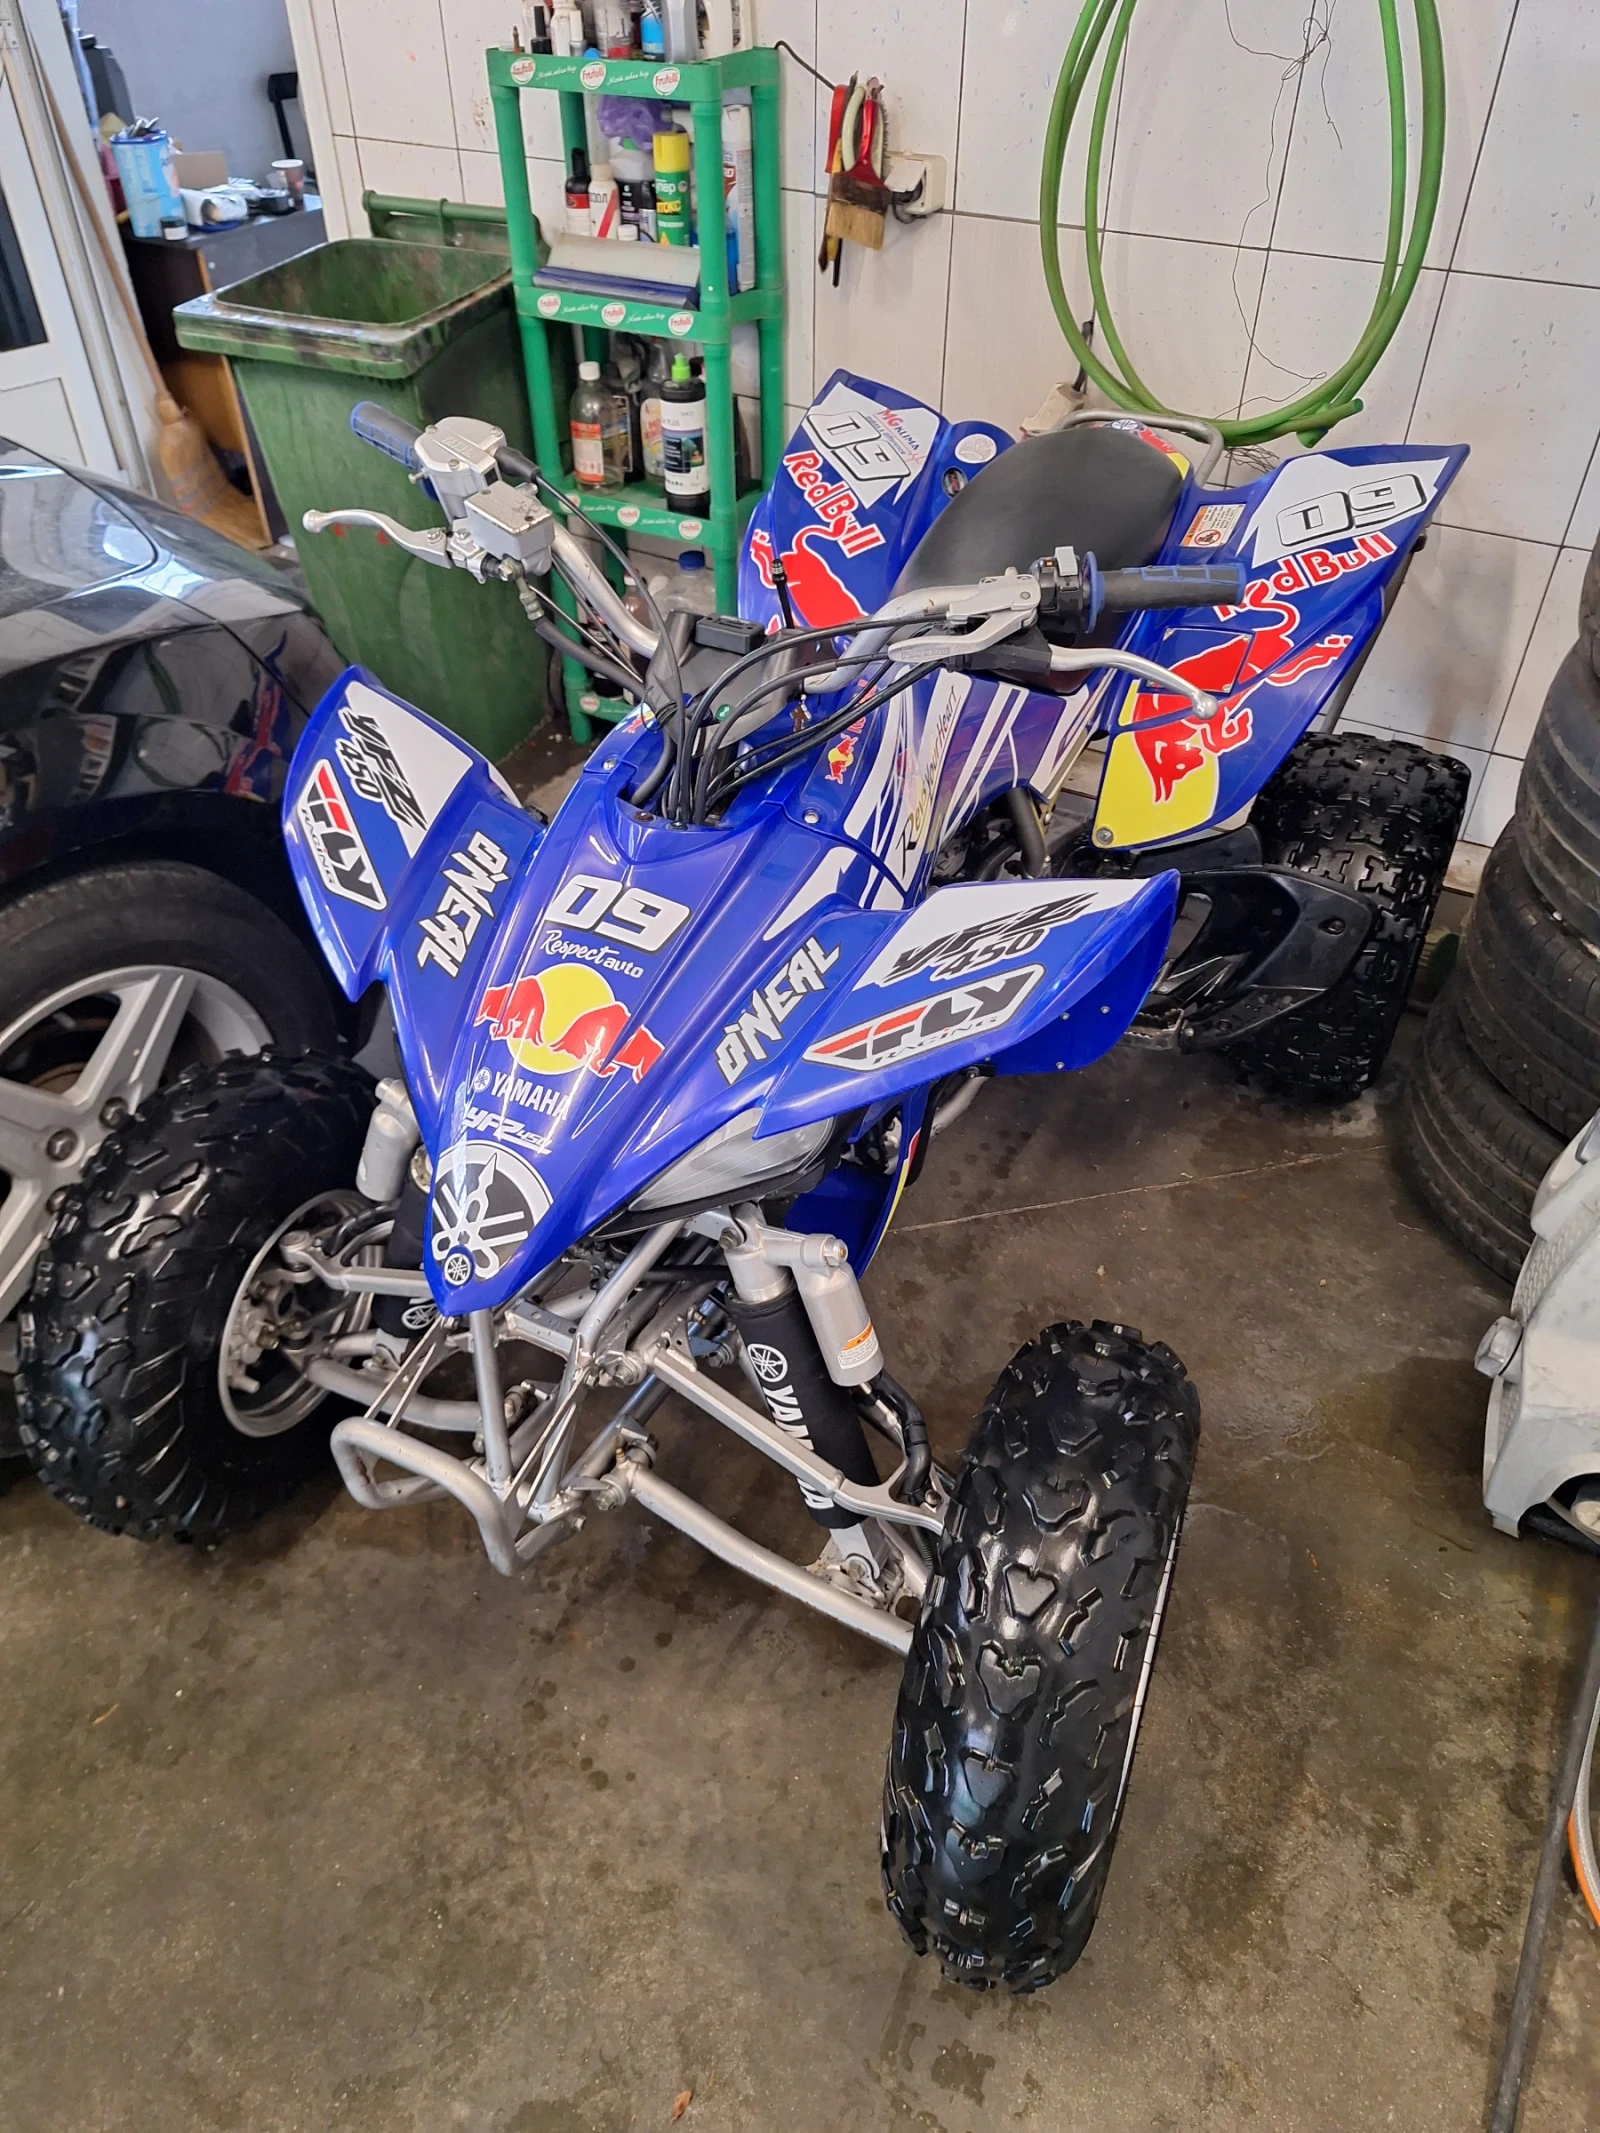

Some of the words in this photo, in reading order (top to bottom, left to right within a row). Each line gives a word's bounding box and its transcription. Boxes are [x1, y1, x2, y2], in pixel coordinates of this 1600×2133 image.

[806, 410, 912, 482] 09
[1275, 473, 1428, 548] 09
[1300, 531, 1398, 586] Bull
[336, 740, 383, 800] 450
[544, 874, 691, 954] 09
[934, 927, 1045, 979] 450
[810, 972, 1031, 1062] FLY
[872, 1015, 999, 1066] RACING
[490, 1070, 571, 1121] YAMAHA
[762, 1384, 835, 1510] YAMA
